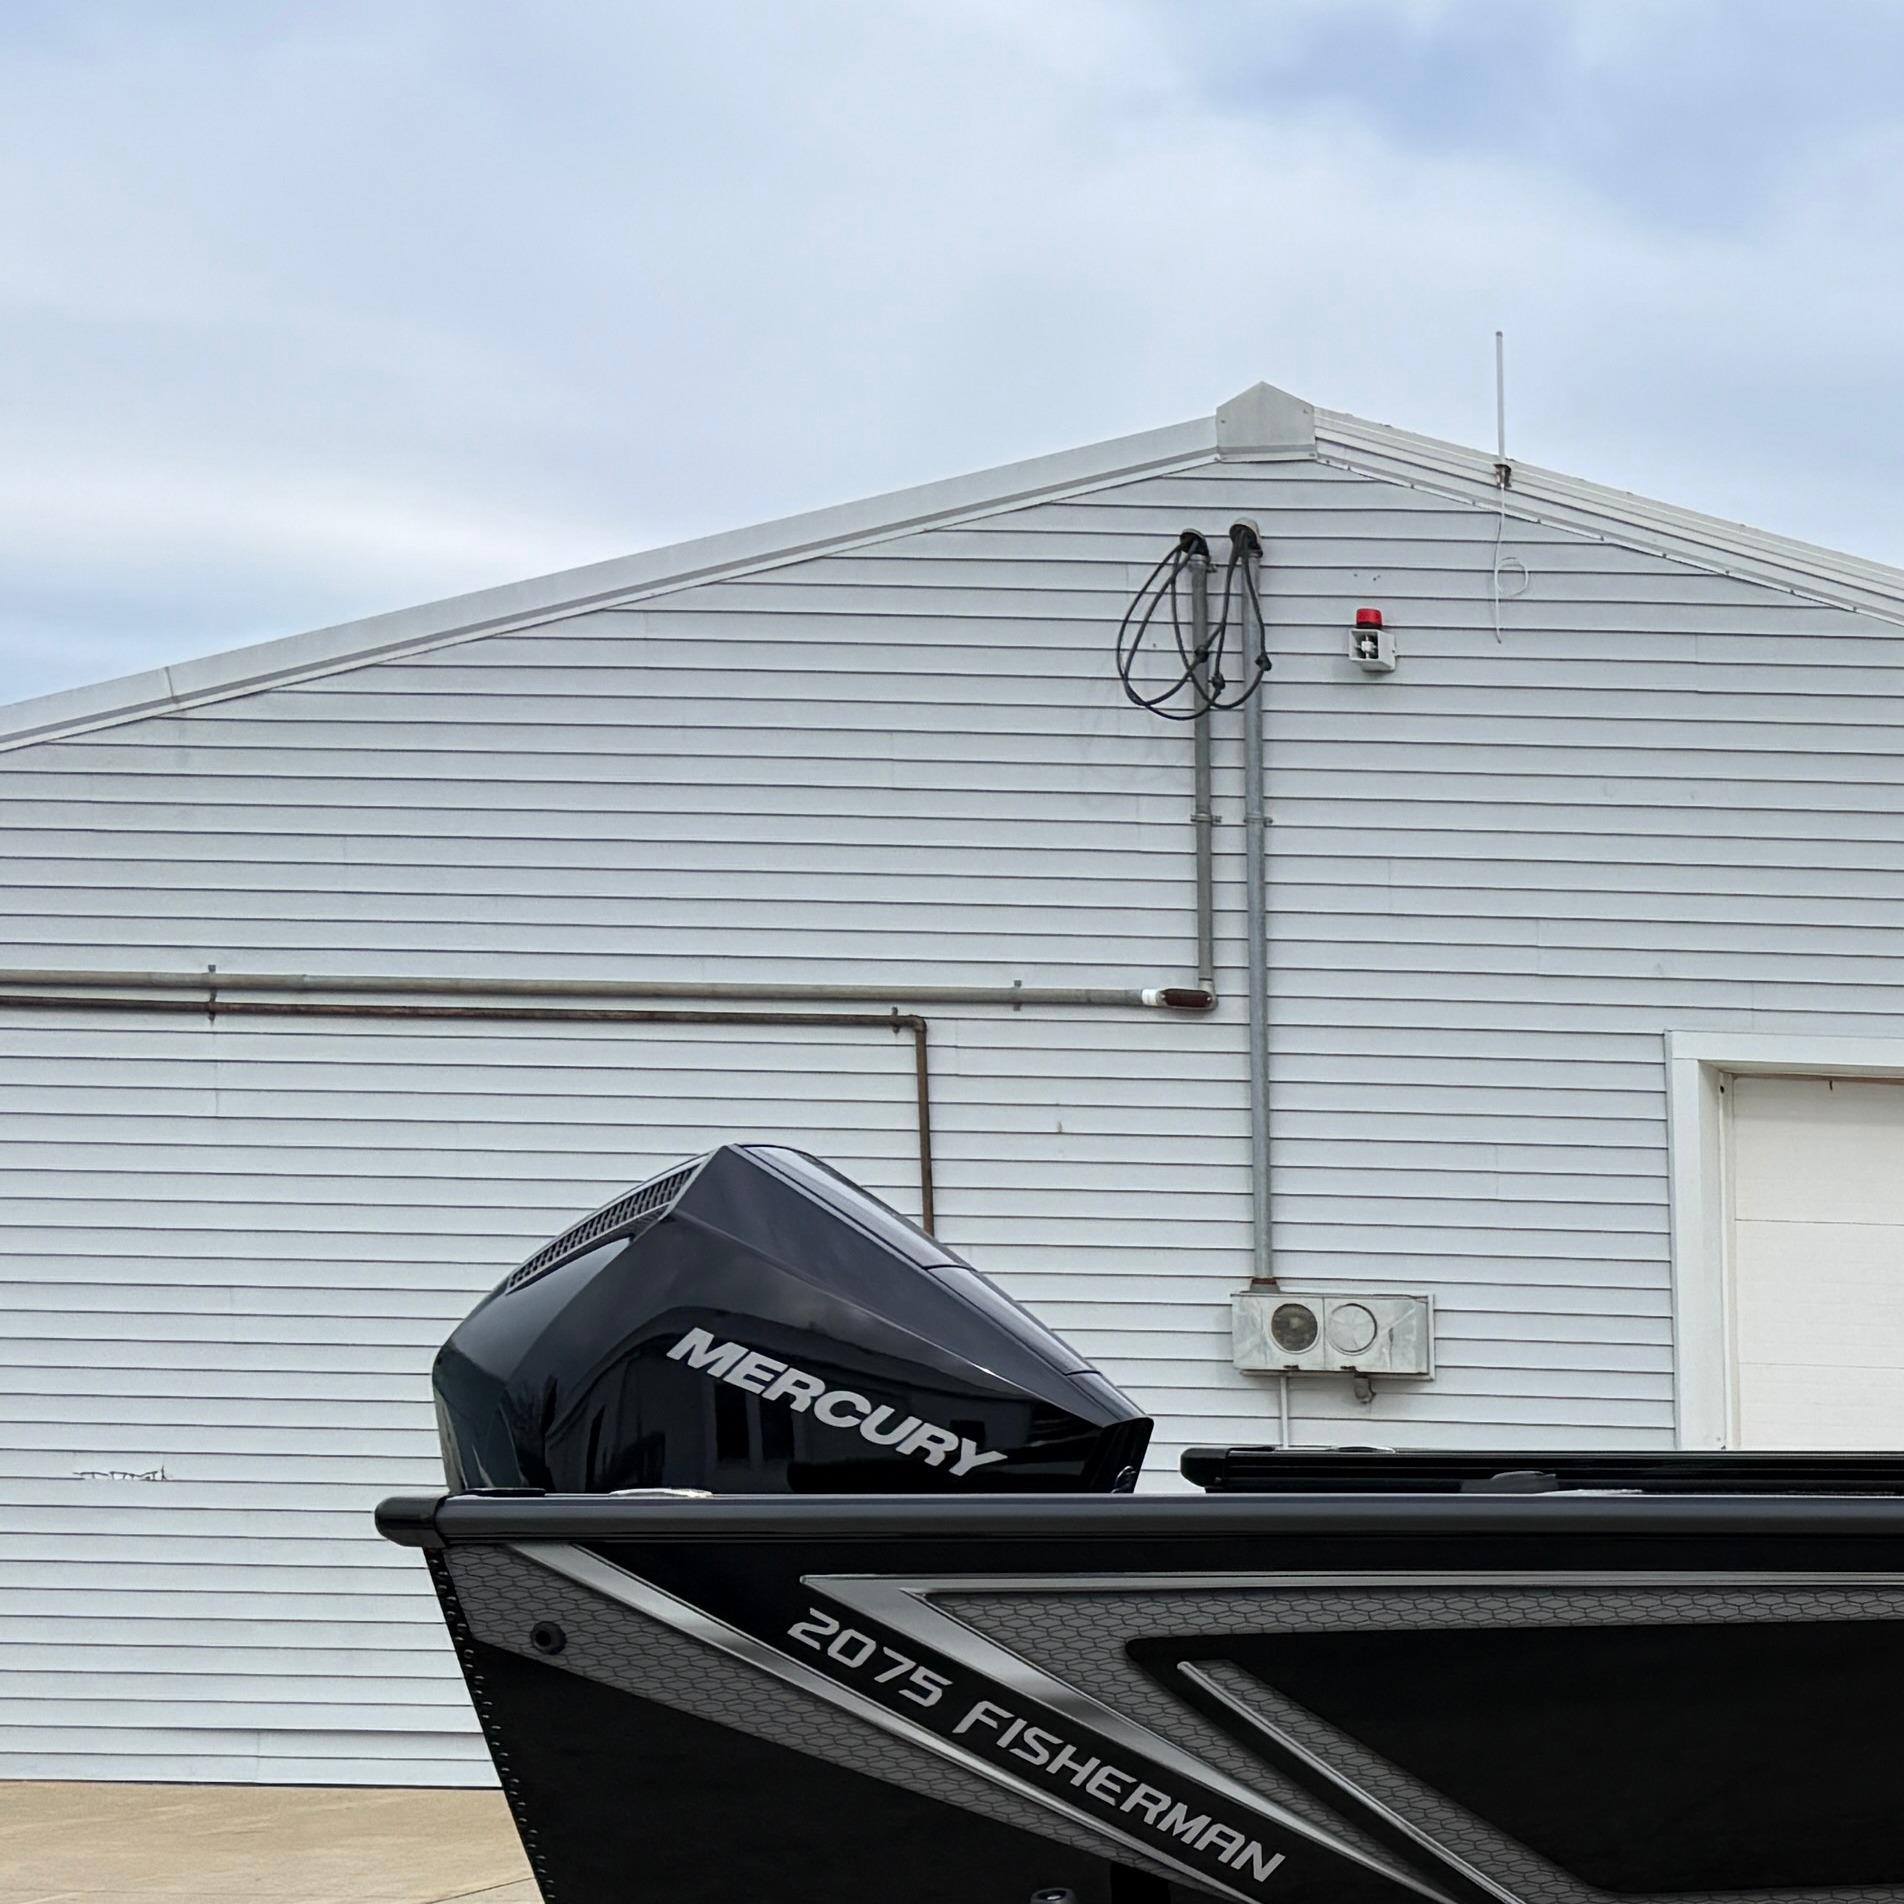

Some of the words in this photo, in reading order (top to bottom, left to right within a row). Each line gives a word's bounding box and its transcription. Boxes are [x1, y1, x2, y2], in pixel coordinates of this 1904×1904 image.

[666, 1327, 1007, 1478] MERCURY
[788, 1607, 954, 1709] 2075
[952, 1699, 1290, 1885] FISHERMAN
